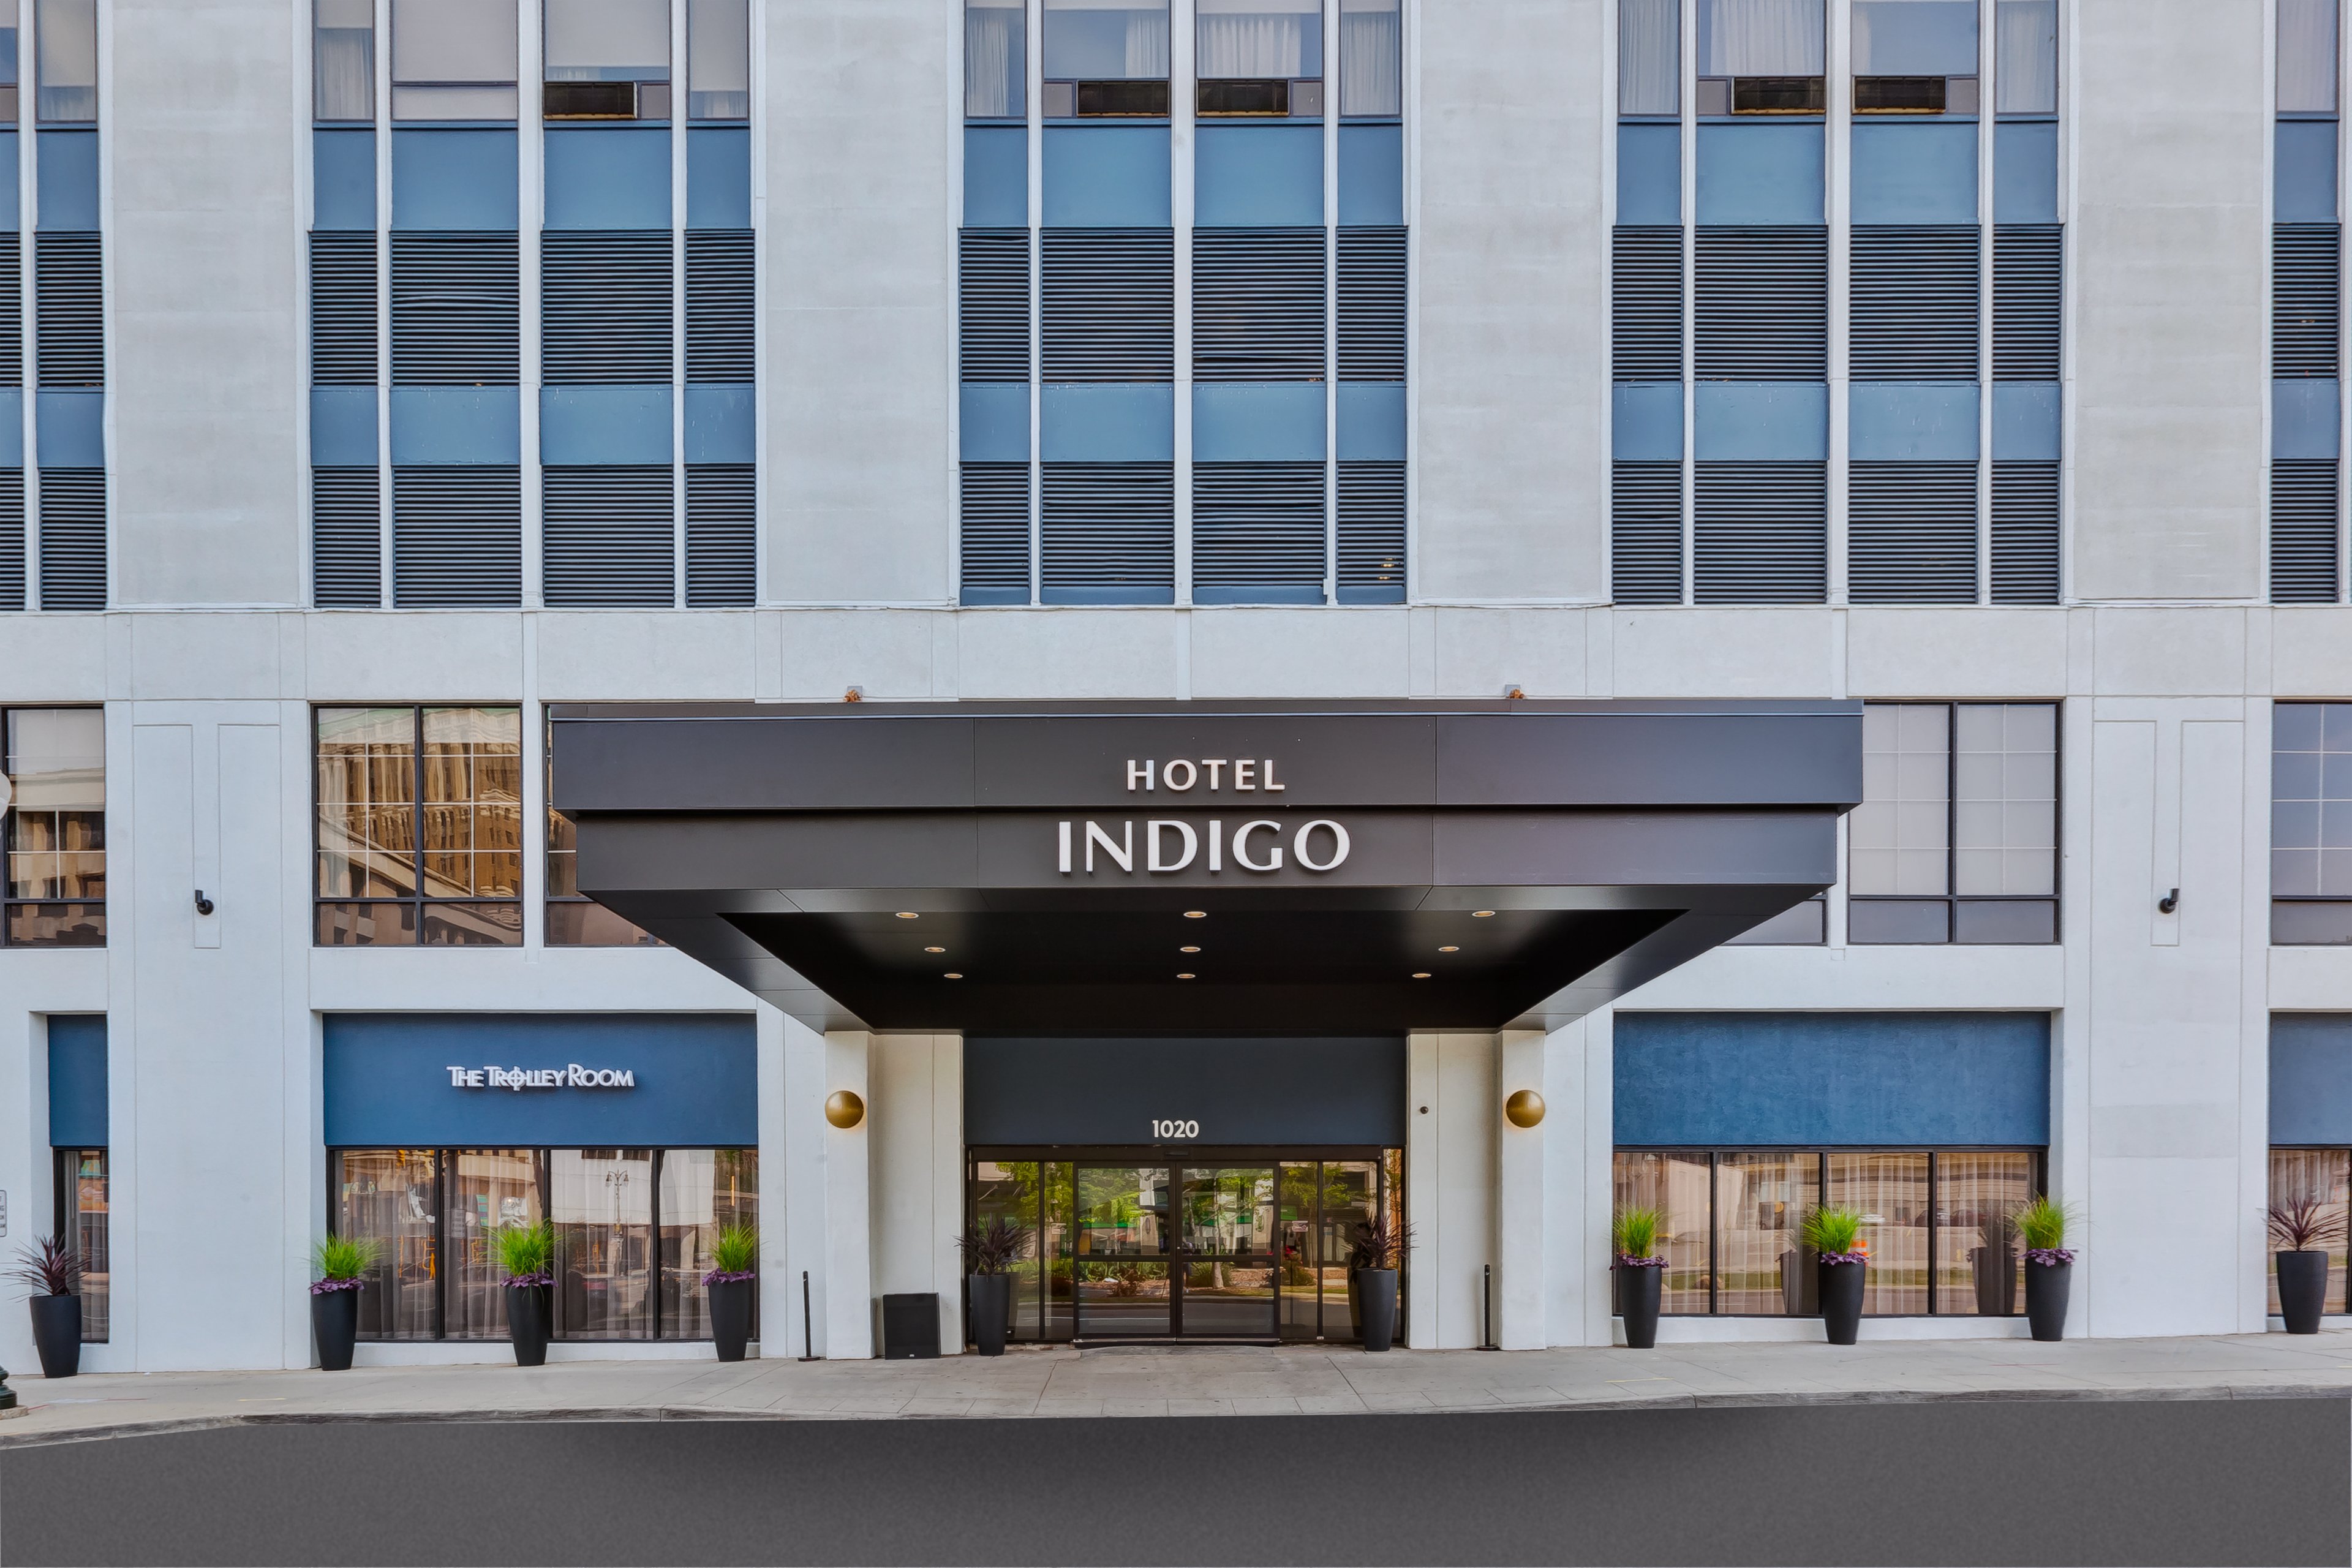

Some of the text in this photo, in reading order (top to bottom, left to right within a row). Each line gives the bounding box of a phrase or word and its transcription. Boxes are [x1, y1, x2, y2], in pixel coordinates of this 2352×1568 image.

[1126, 758, 1286, 791] HOTEL
[1058, 818, 1351, 873] INDIGO
[446, 1063, 635, 1091] THE TROLLEY ROOM
[1152, 1120, 1199, 1138] 1020
